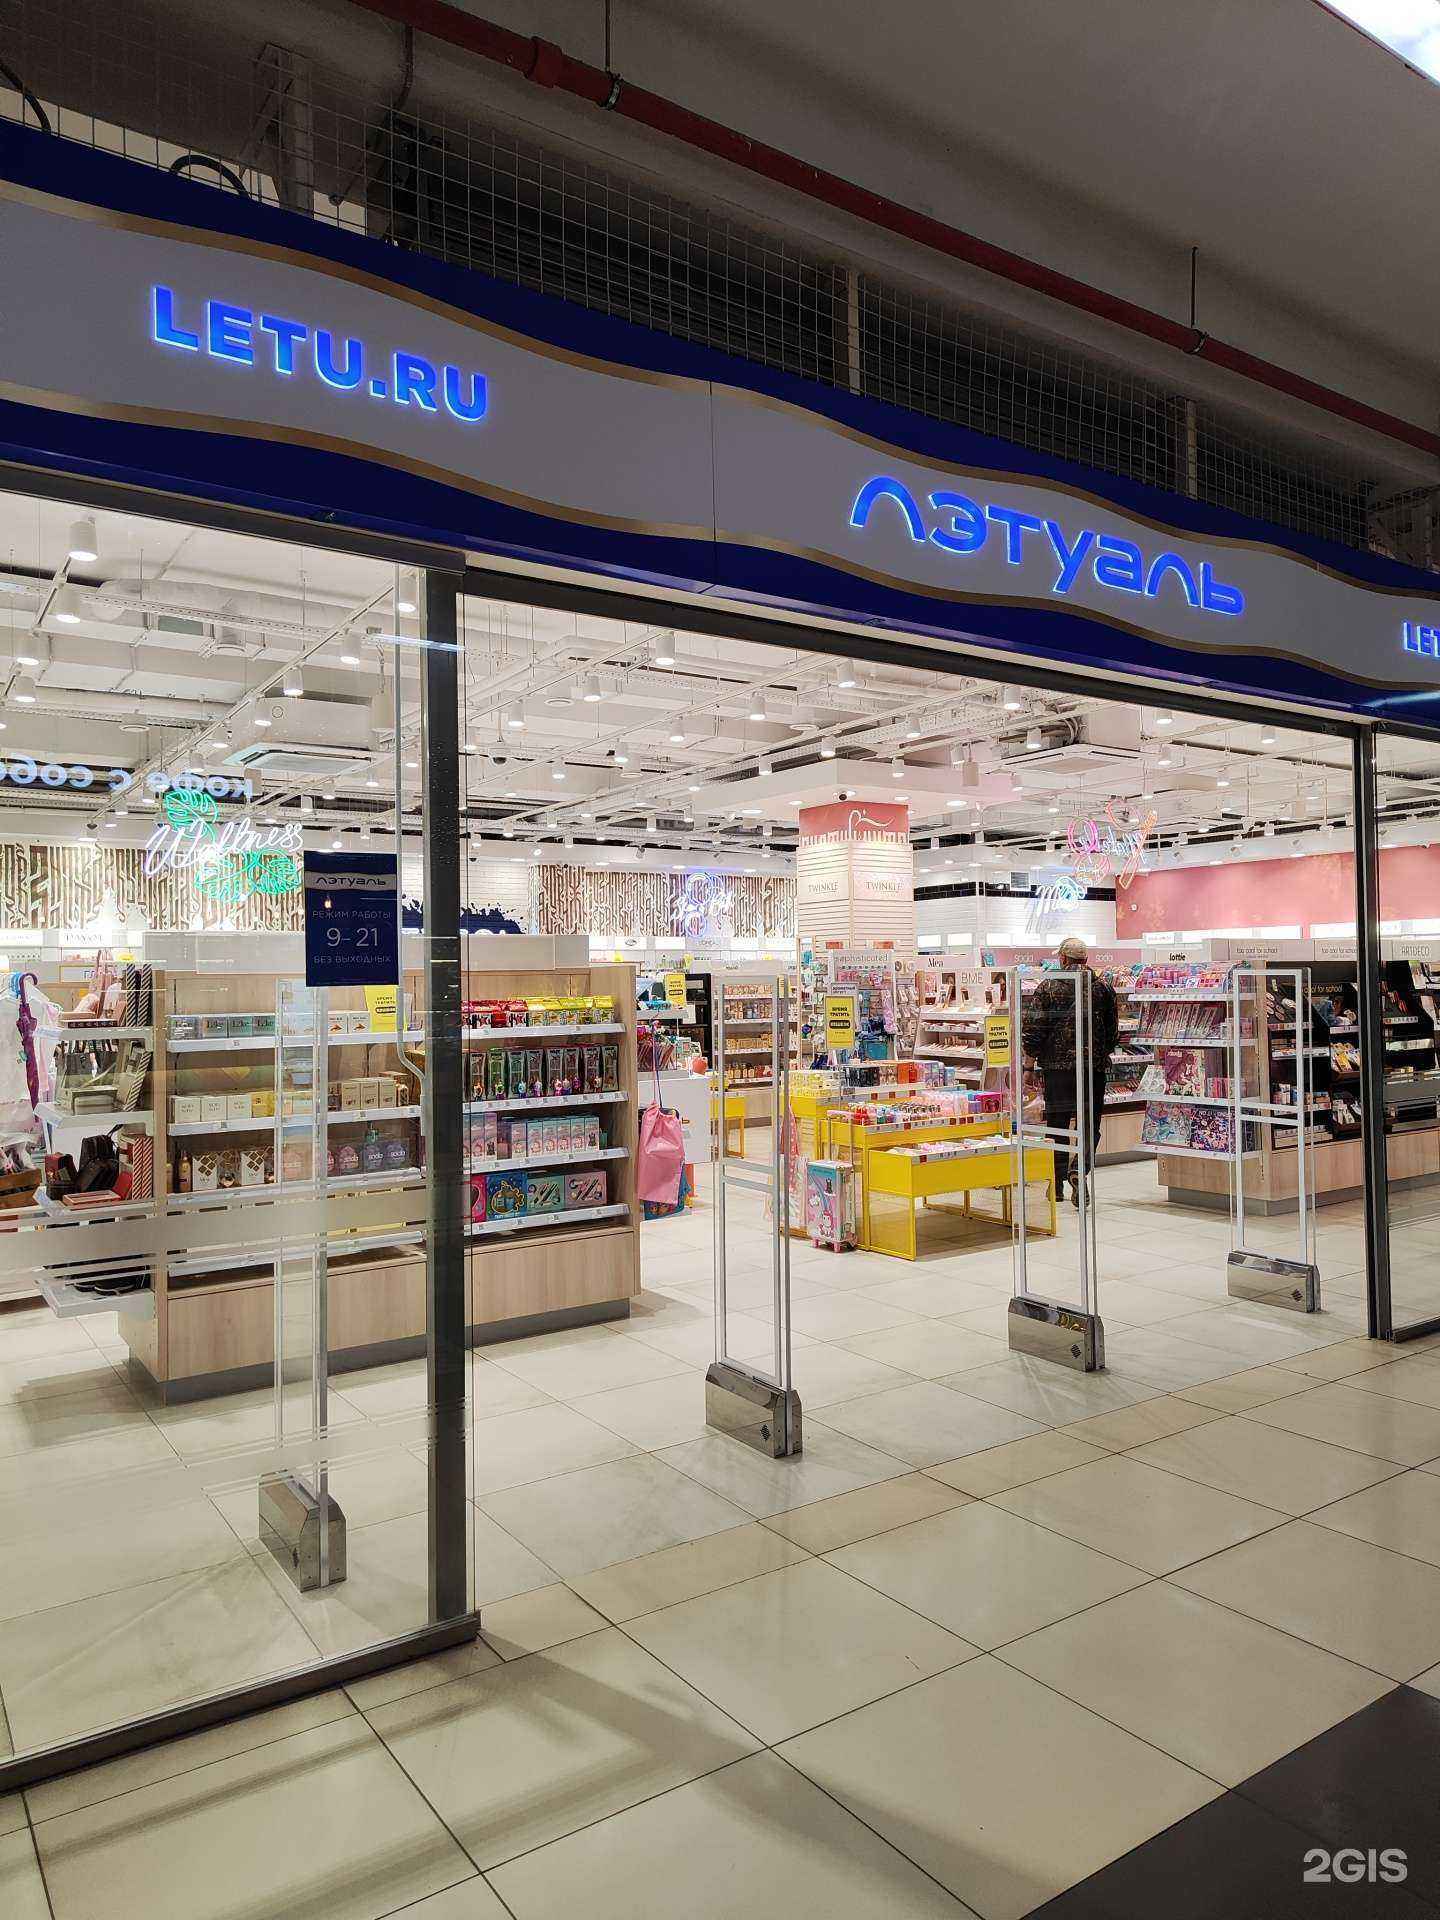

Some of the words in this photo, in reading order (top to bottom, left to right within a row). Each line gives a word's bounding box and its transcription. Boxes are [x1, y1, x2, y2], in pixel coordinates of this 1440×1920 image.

[150, 285, 489, 423] LETU.RU
[312, 910, 349, 919] РЕЖИМ
[352, 910, 391, 919] РАБОТЫ
[1401, 945, 1430, 957] ARTDECO
[335, 955, 392, 964] ВЫХОДНЫХ
